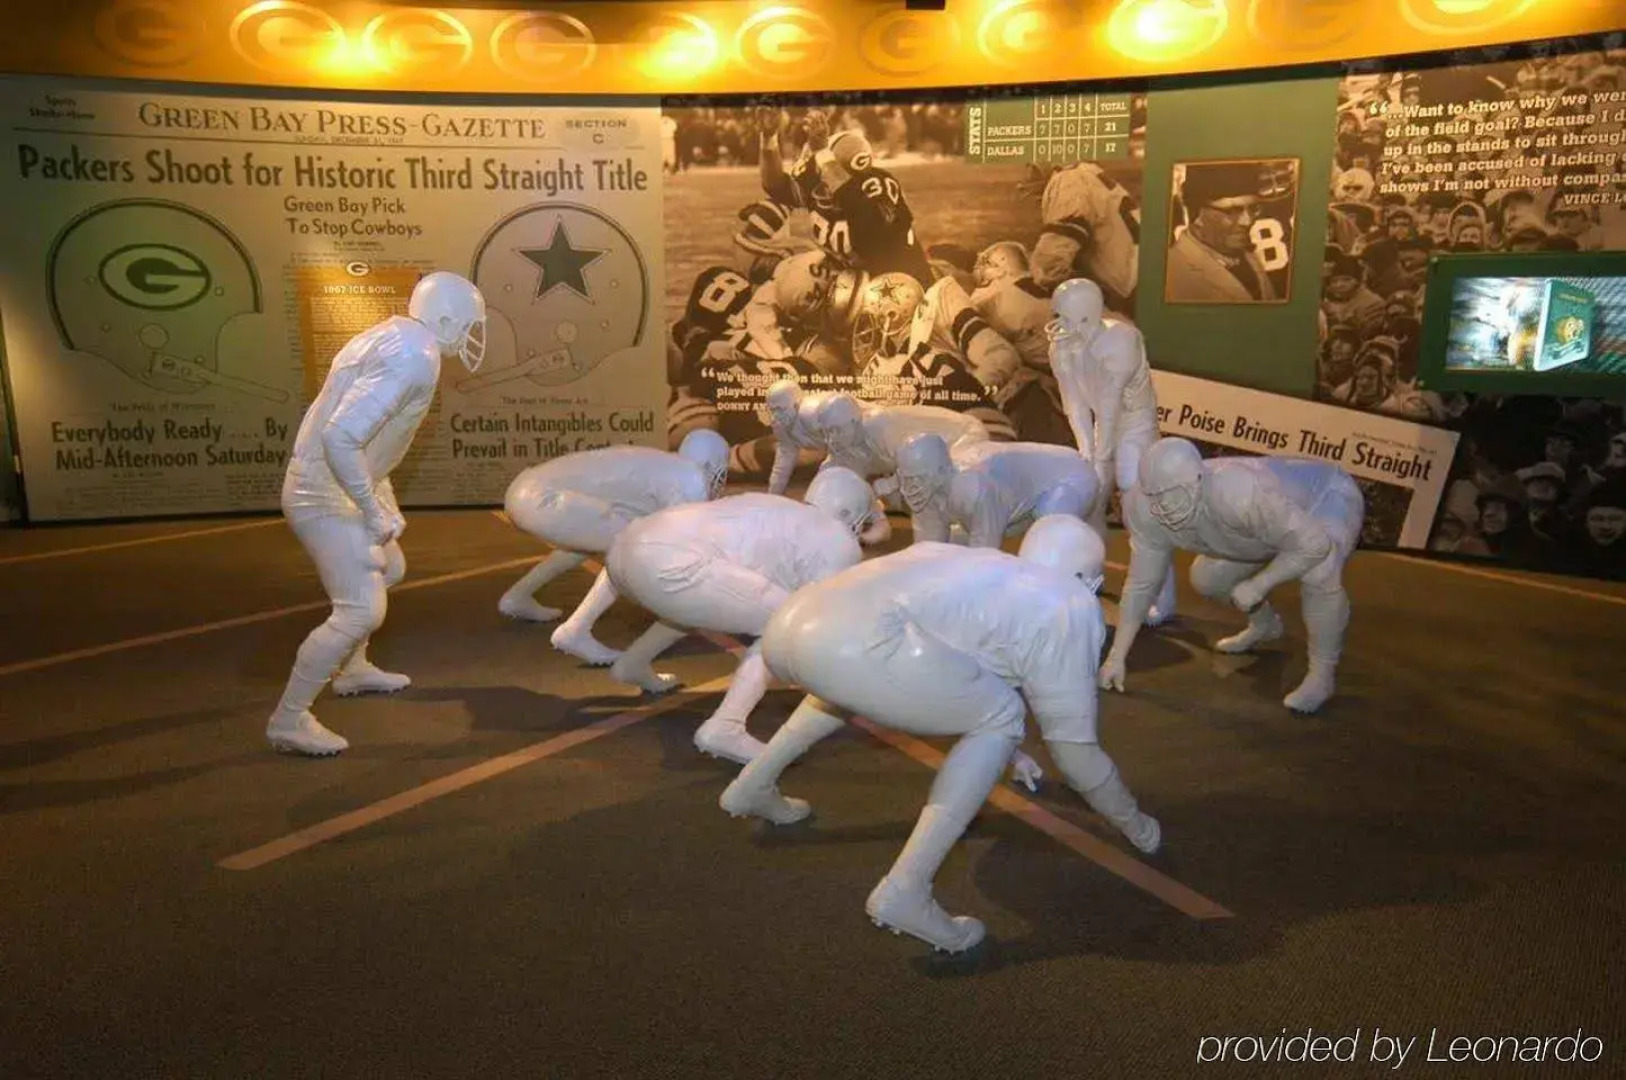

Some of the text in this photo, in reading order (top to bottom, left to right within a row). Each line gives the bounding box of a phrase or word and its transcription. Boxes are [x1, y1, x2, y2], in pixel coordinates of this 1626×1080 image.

[1041, 102, 1127, 114] 1 2 3 4 TOTAL
[1447, 103, 1463, 115] to
[1468, 101, 1515, 113] know
[1519, 95, 1556, 111] why
[1561, 94, 1588, 106] we
[138, 101, 546, 138] GREEN BAY PRESS-GAZETTE
[565, 119, 627, 129] SECTION
[987, 126, 1032, 136] PACKERS
[1084, 123, 1090, 132] 7
[1385, 124, 1402, 138] of
[1405, 123, 1430, 136] the
[1433, 121, 1470, 135] field
[1474, 117, 1520, 136] goal?
[1525, 113, 1596, 129] Because
[1601, 109, 1609, 123] I
[592, 133, 604, 144] C
[969, 107, 981, 155] STATS
[987, 145, 1024, 156] DALLAS
[1038, 145, 1046, 154] 0
[1383, 146, 1403, 159] up
[1407, 143, 1422, 155] in
[1427, 141, 1452, 154] the
[1456, 138, 1510, 152] stands
[1515, 137, 1531, 149] to
[1536, 134, 1558, 147] sit
[18, 143, 647, 197] Packers Shoot for Historic Third Straight Title
[1381, 161, 1411, 175] I've
[1415, 161, 1454, 174] been
[1458, 155, 1525, 171] accused
[1530, 153, 1547, 167] of
[1551, 152, 1617, 167] lacking
[861, 176, 900, 205] 30
[1380, 180, 1430, 194] shows
[1433, 179, 1459, 191] I'm
[1463, 178, 1490, 190] not
[1495, 174, 1559, 188] without
[284, 195, 406, 216] Green Bay Pick
[1564, 193, 1610, 204] VINCE
[285, 217, 423, 239] To Stop Cowboys
[1249, 218, 1289, 271] 8
[349, 285, 366, 294] ICE
[368, 285, 396, 294] BOWL
[810, 373, 833, 384] that
[836, 375, 854, 384] we
[717, 386, 755, 398] played
[920, 389, 932, 400] of
[934, 390, 949, 400] all
[52, 418, 154, 444] Everybody
[164, 417, 222, 443] Ready
[266, 416, 288, 441] By
[450, 411, 655, 436] Certain Intangibles Could
[452, 438, 507, 458] Prevail
[513, 439, 528, 457] in
[533, 438, 568, 458] Title
[1178, 404, 1226, 434] Poise
[1233, 415, 1289, 449] Brings
[1298, 429, 1347, 461] Third
[1351, 441, 1433, 481] Straight
[56, 442, 287, 470] Mid-Afternoon Saturday
